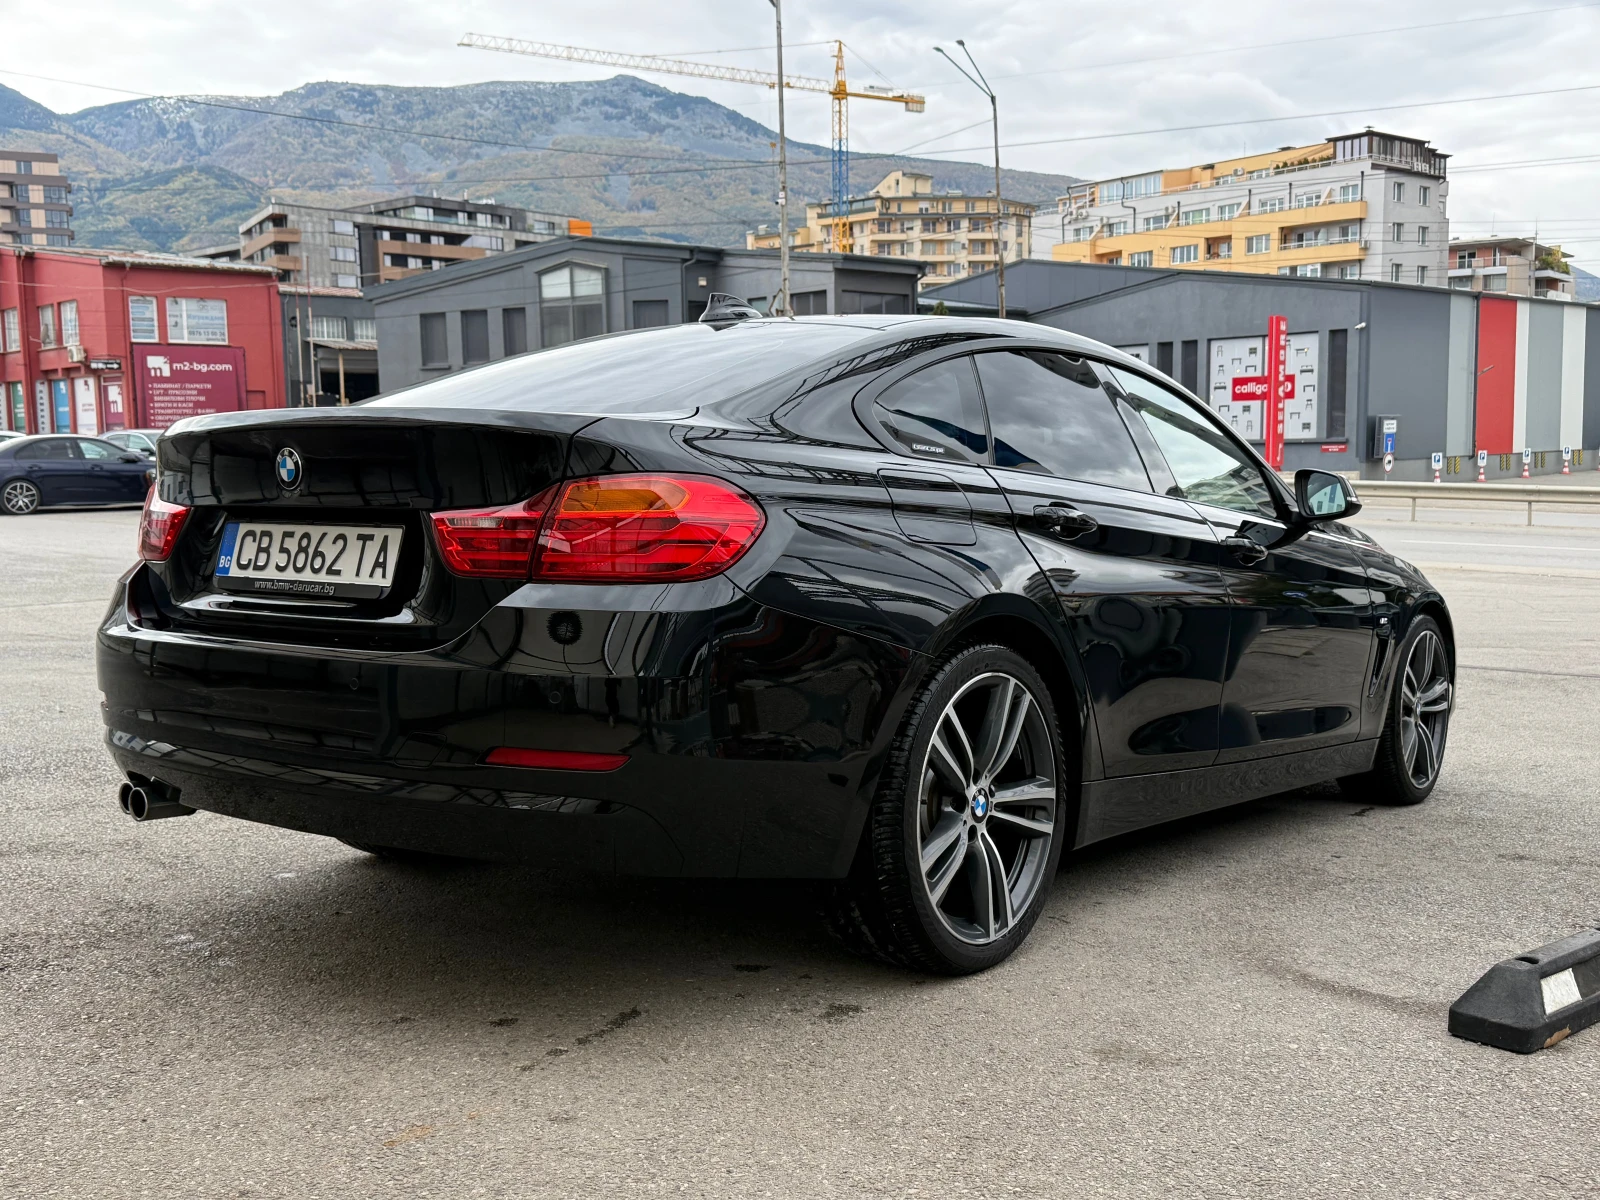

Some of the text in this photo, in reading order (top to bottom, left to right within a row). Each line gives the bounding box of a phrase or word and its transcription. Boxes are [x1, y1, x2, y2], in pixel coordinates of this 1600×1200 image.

[172, 361, 233, 373] m2-bg.com
[219, 555, 231, 569] BG
[254, 579, 335, 596] www.bmw-darucar.bg
